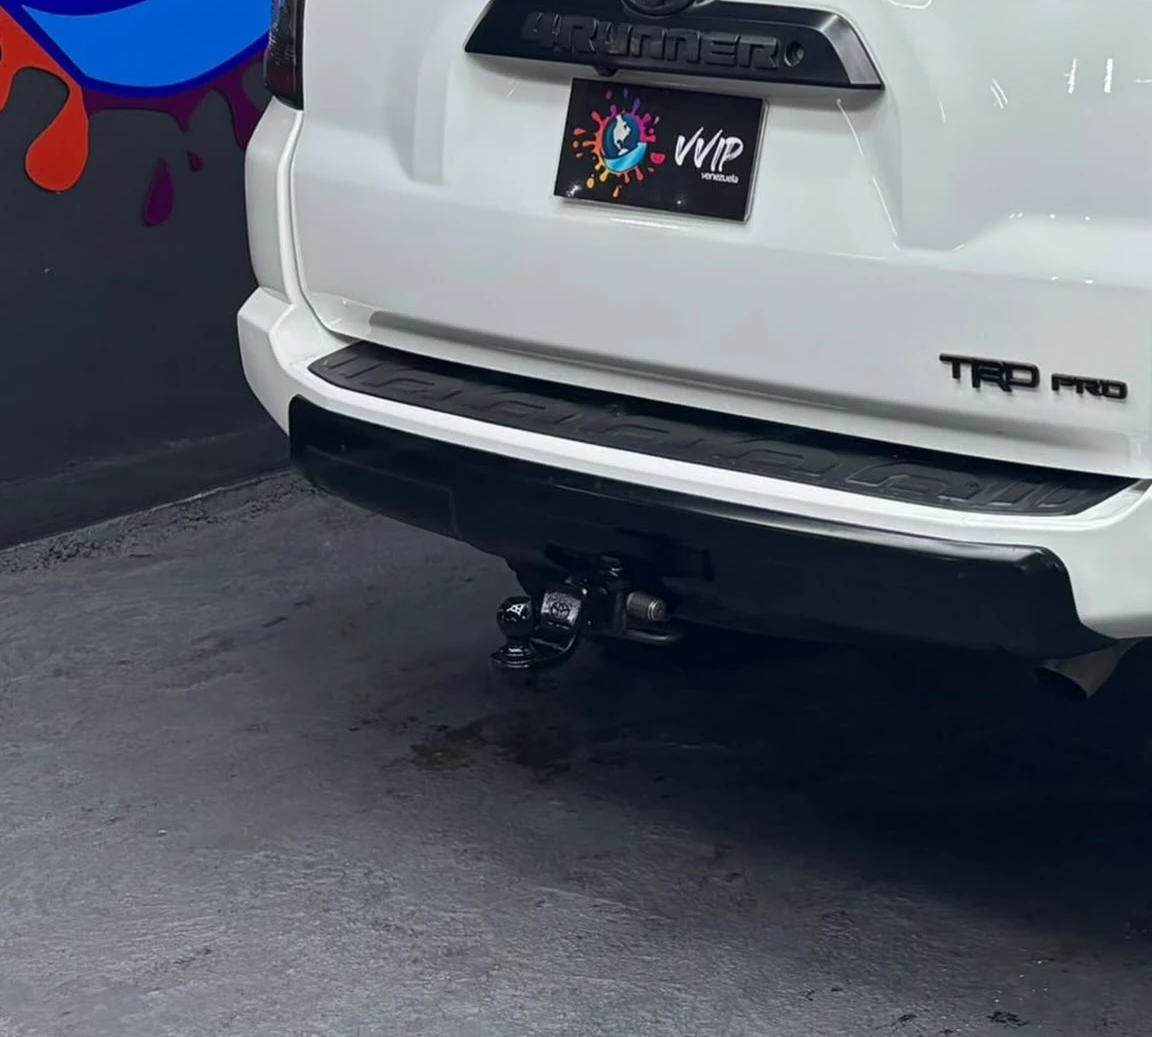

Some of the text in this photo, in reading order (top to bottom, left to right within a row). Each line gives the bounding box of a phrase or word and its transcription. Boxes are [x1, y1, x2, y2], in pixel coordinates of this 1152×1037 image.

[521, 12, 781, 71] 4RUNNER
[674, 126, 744, 172] VVIP
[701, 172, 739, 184] venezuela
[939, 353, 1128, 400] TRD PRO
